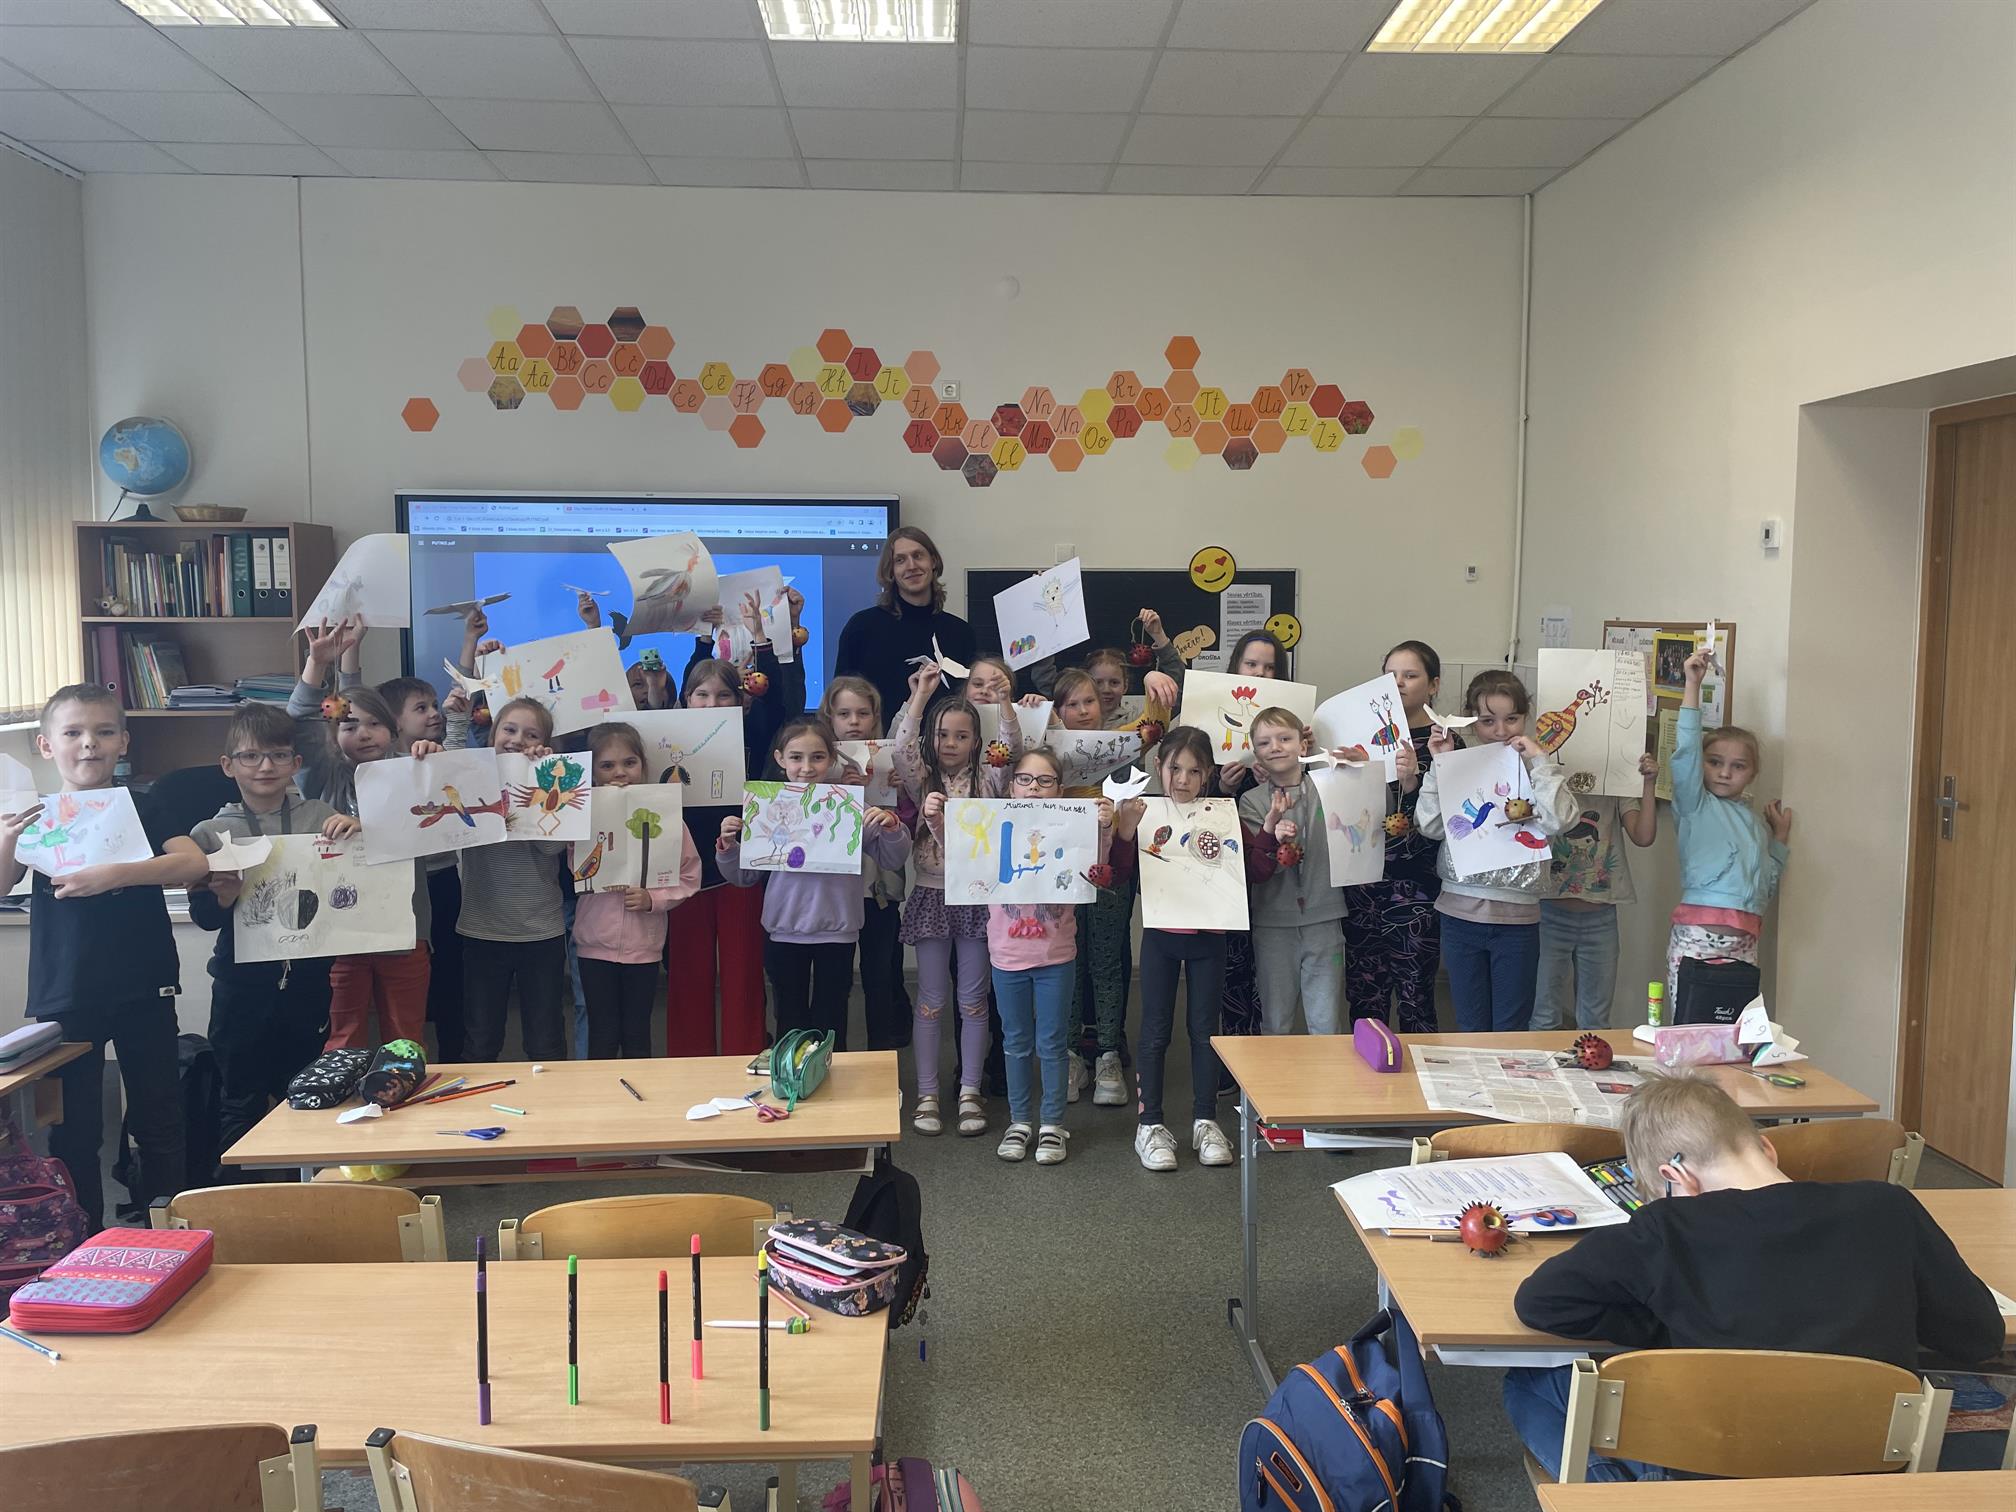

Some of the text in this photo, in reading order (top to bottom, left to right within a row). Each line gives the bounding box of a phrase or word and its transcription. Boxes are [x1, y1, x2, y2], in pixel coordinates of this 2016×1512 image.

[492, 346, 519, 371] Aa
[554, 345, 580, 371] Bb
[524, 360, 550, 387] Āā
[583, 364, 608, 389] Cc
[673, 384, 697, 408] Ee
[1111, 374, 1136, 399] Rr
[1025, 389, 1052, 415] Nn
[1200, 391, 1222, 416] Tt
[1286, 407, 1308, 432] Zz
[966, 423, 990, 449] Ll
[1084, 426, 1109, 450] Oo
